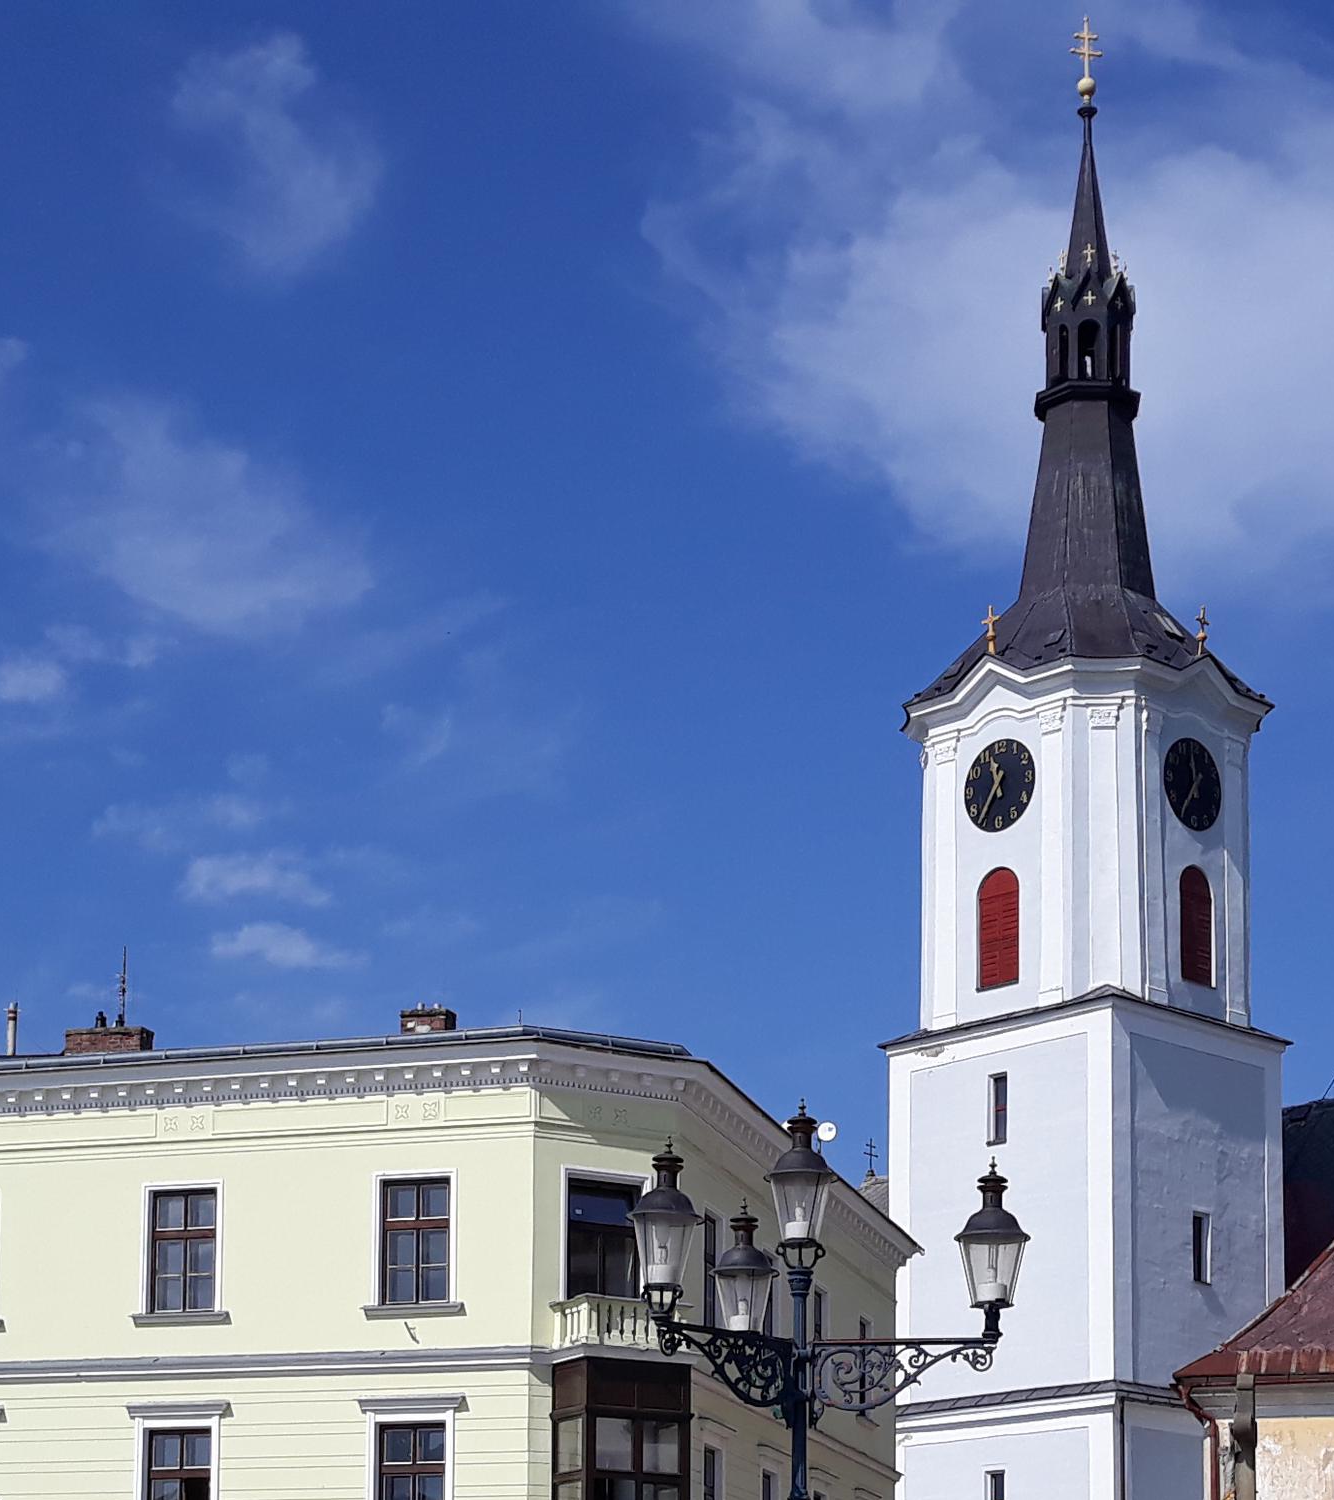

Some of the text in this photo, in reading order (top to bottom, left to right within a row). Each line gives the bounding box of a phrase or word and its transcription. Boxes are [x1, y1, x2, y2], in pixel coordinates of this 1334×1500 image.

[995, 741, 1006, 754] 12
[1012, 742, 1018, 754] 1
[980, 750, 990, 763] 11
[1020, 752, 1028, 764] 2
[969, 767, 980, 780] 10
[1025, 770, 1032, 782] 3
[966, 787, 973, 799] 9
[1020, 791, 1028, 803] 4
[970, 804, 978, 817] 8
[1010, 806, 1017, 819] 5
[995, 816, 1003, 828] 6
